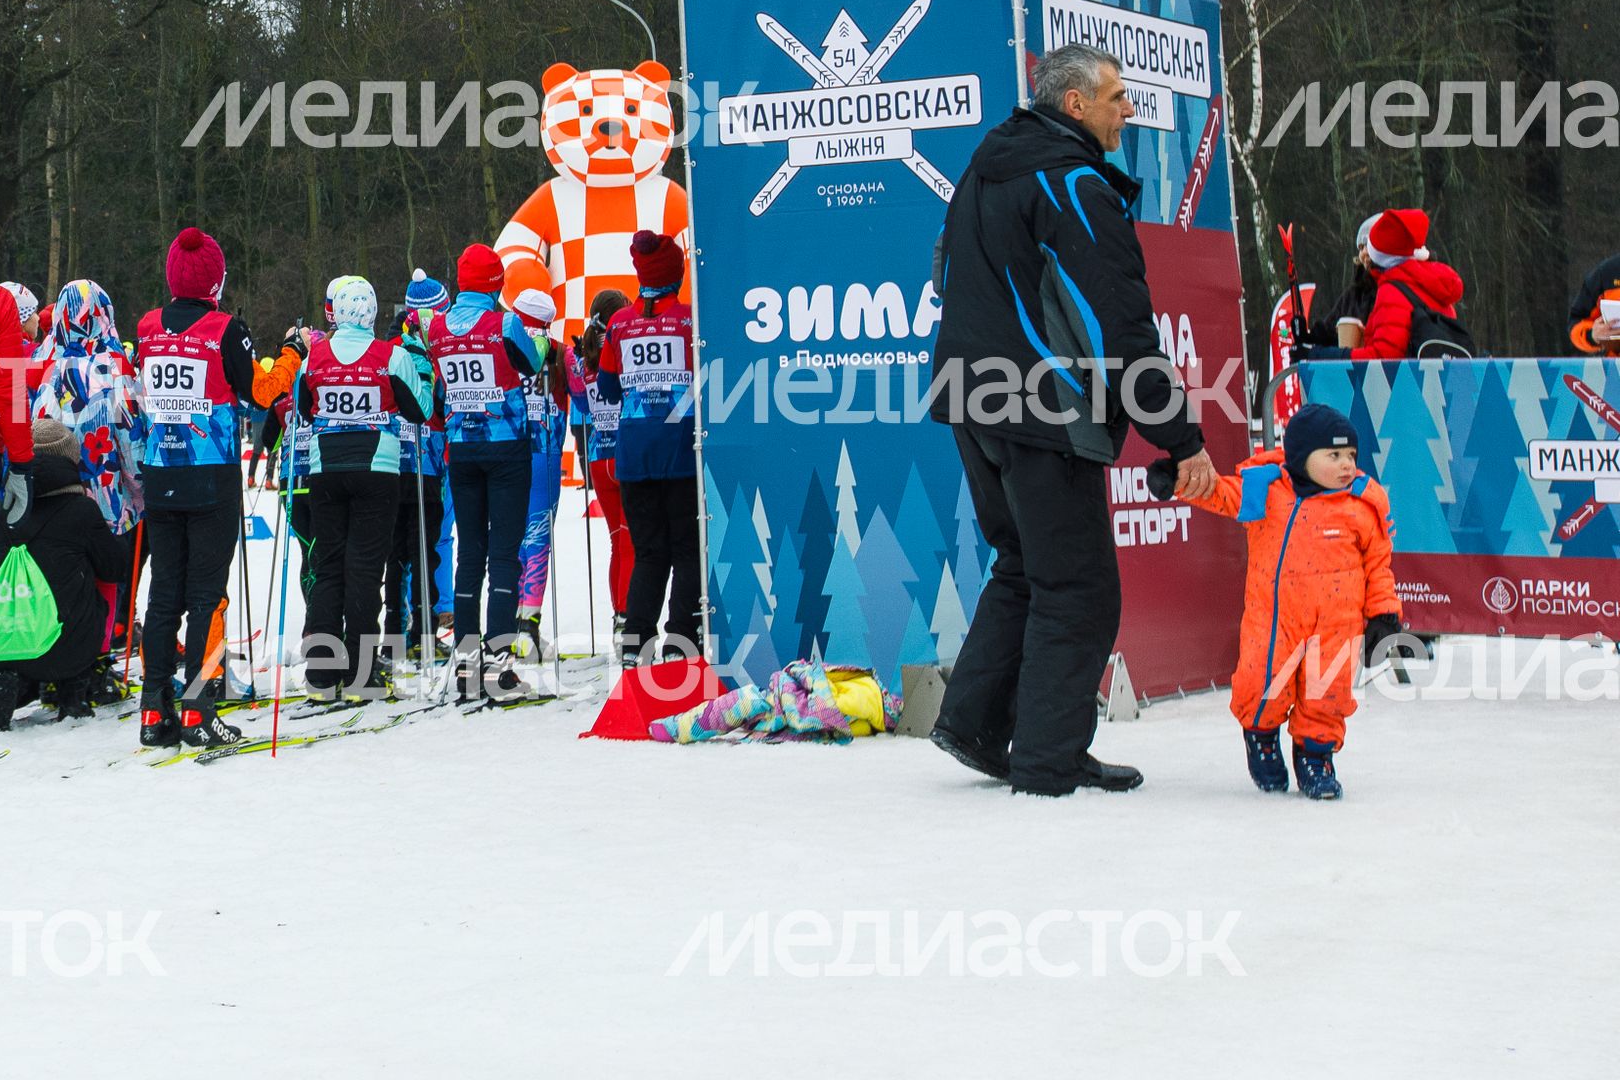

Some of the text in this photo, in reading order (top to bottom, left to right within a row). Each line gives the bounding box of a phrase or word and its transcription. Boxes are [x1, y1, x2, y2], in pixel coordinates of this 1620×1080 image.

[1049, 6, 1206, 83] МАНЖОСОВСКАЯ
[833, 47, 857, 69] 54
[728, 84, 972, 135] МАНЖОСОВСКАЯ
[1126, 87, 1158, 121] ЖНЯ
[815, 135, 885, 161] ЛЫЖНЯ
[816, 182, 886, 196] ОСНОВАНА
[836, 195, 864, 207] 1969
[743, 279, 943, 344] ЗИМА
[631, 341, 673, 366] 981
[780, 350, 930, 369] в Подмосковье
[150, 363, 195, 390] 995
[446, 359, 485, 384] 918
[324, 391, 373, 415] 984
[1113, 506, 1192, 548] СПОРТ
[1393, 582, 1431, 593] МАНДА
[1396, 593, 1451, 605] ЕРНАТОРА
[1521, 578, 1590, 598] ПАРКИ
